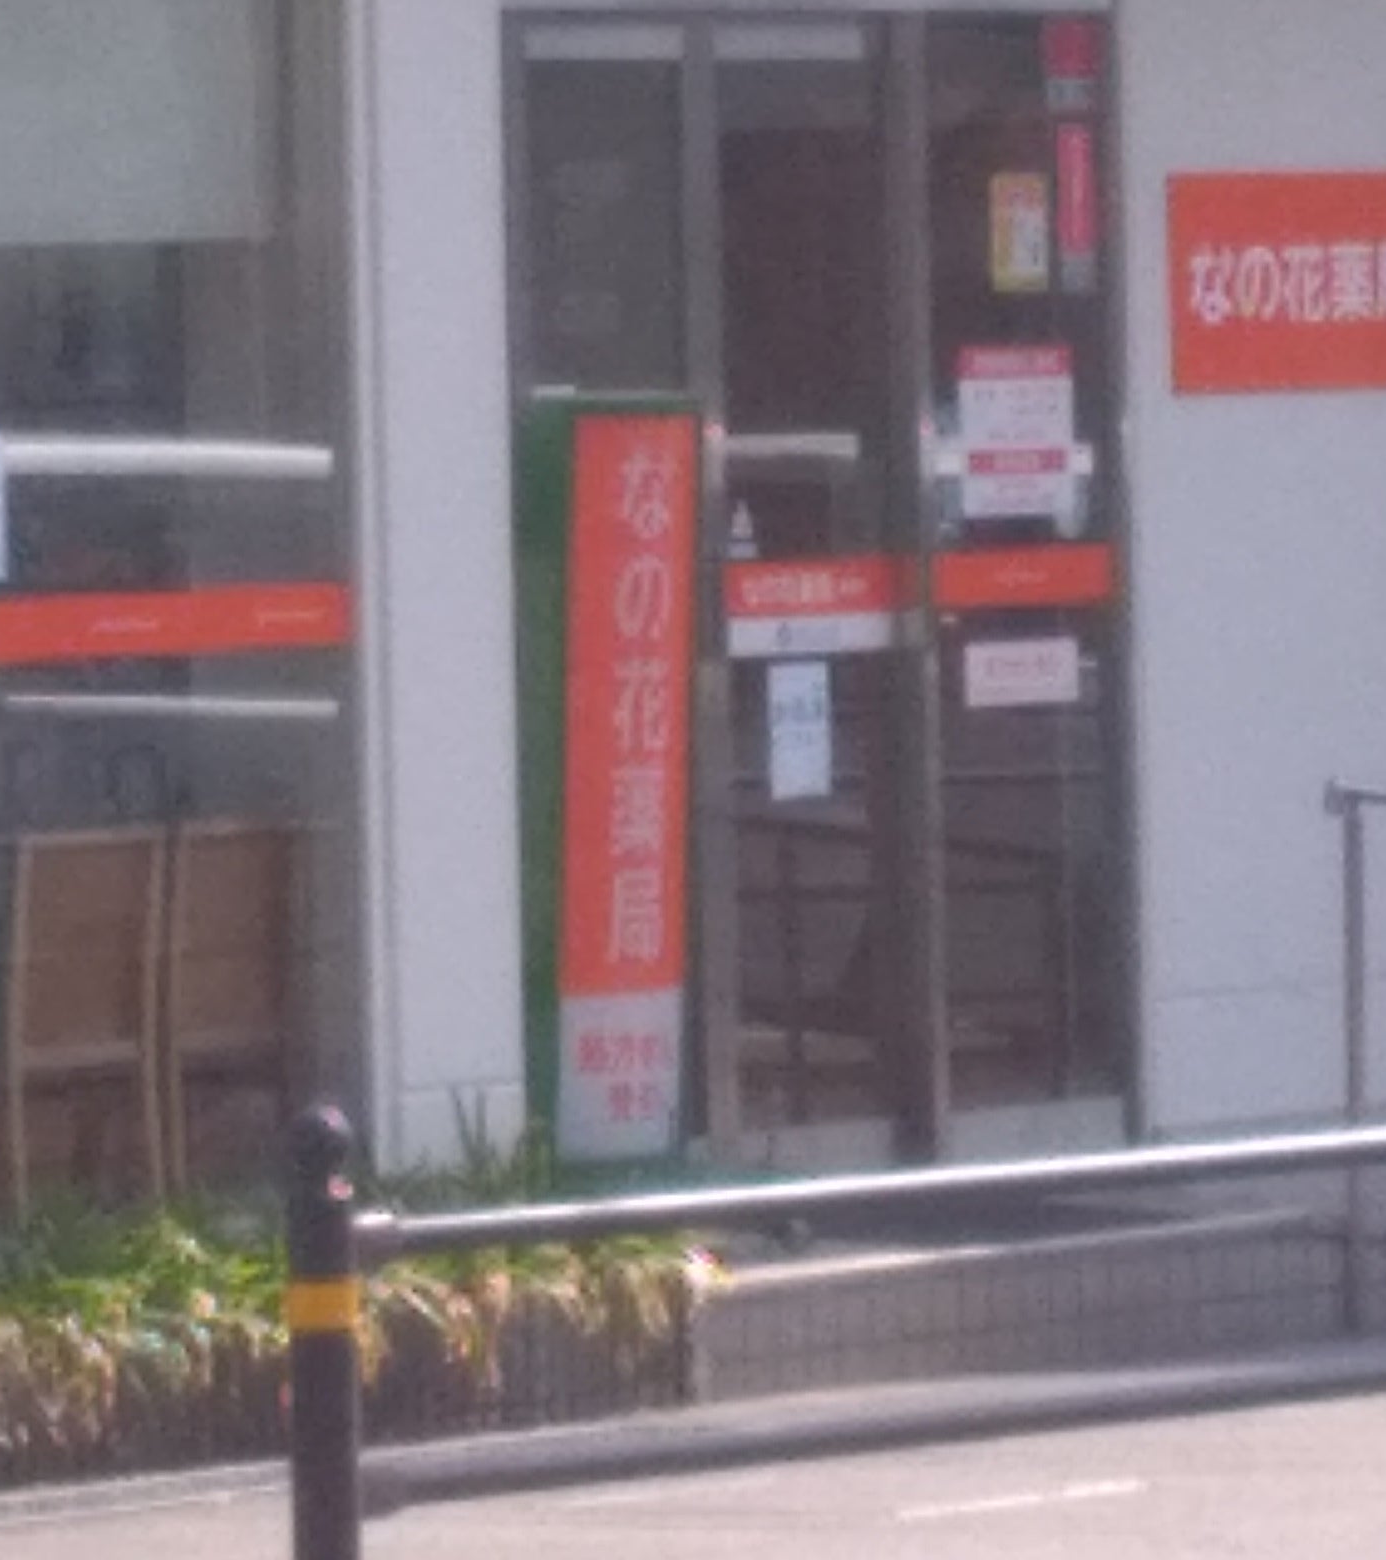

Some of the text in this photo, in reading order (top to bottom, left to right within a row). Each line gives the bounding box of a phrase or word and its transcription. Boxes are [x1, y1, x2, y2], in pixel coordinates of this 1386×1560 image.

[610, 450, 675, 964] なの花薬局
